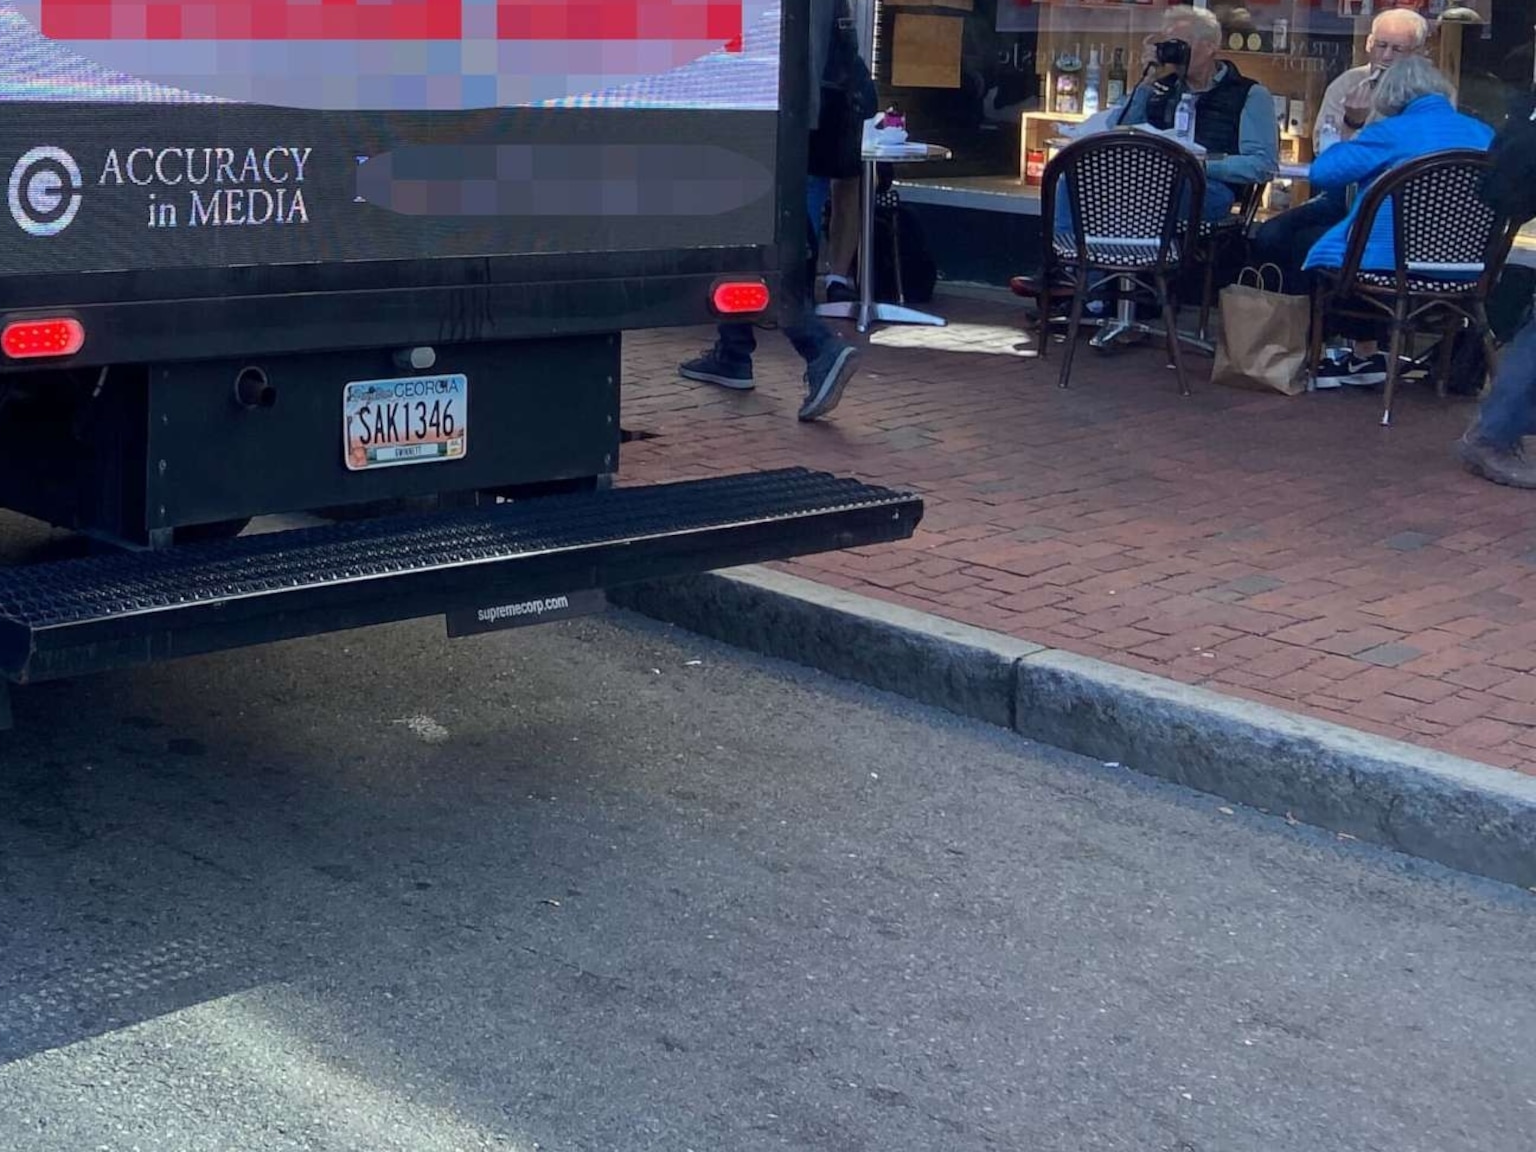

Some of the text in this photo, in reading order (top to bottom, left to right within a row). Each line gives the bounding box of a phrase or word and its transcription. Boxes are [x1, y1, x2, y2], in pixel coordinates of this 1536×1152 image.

[99, 147, 313, 186] ACCURACY
[148, 188, 309, 229] in MEDIA
[394, 380, 459, 398] GEORGIA
[359, 399, 455, 445] SAK1346
[477, 595, 569, 623] supremecorp.com
